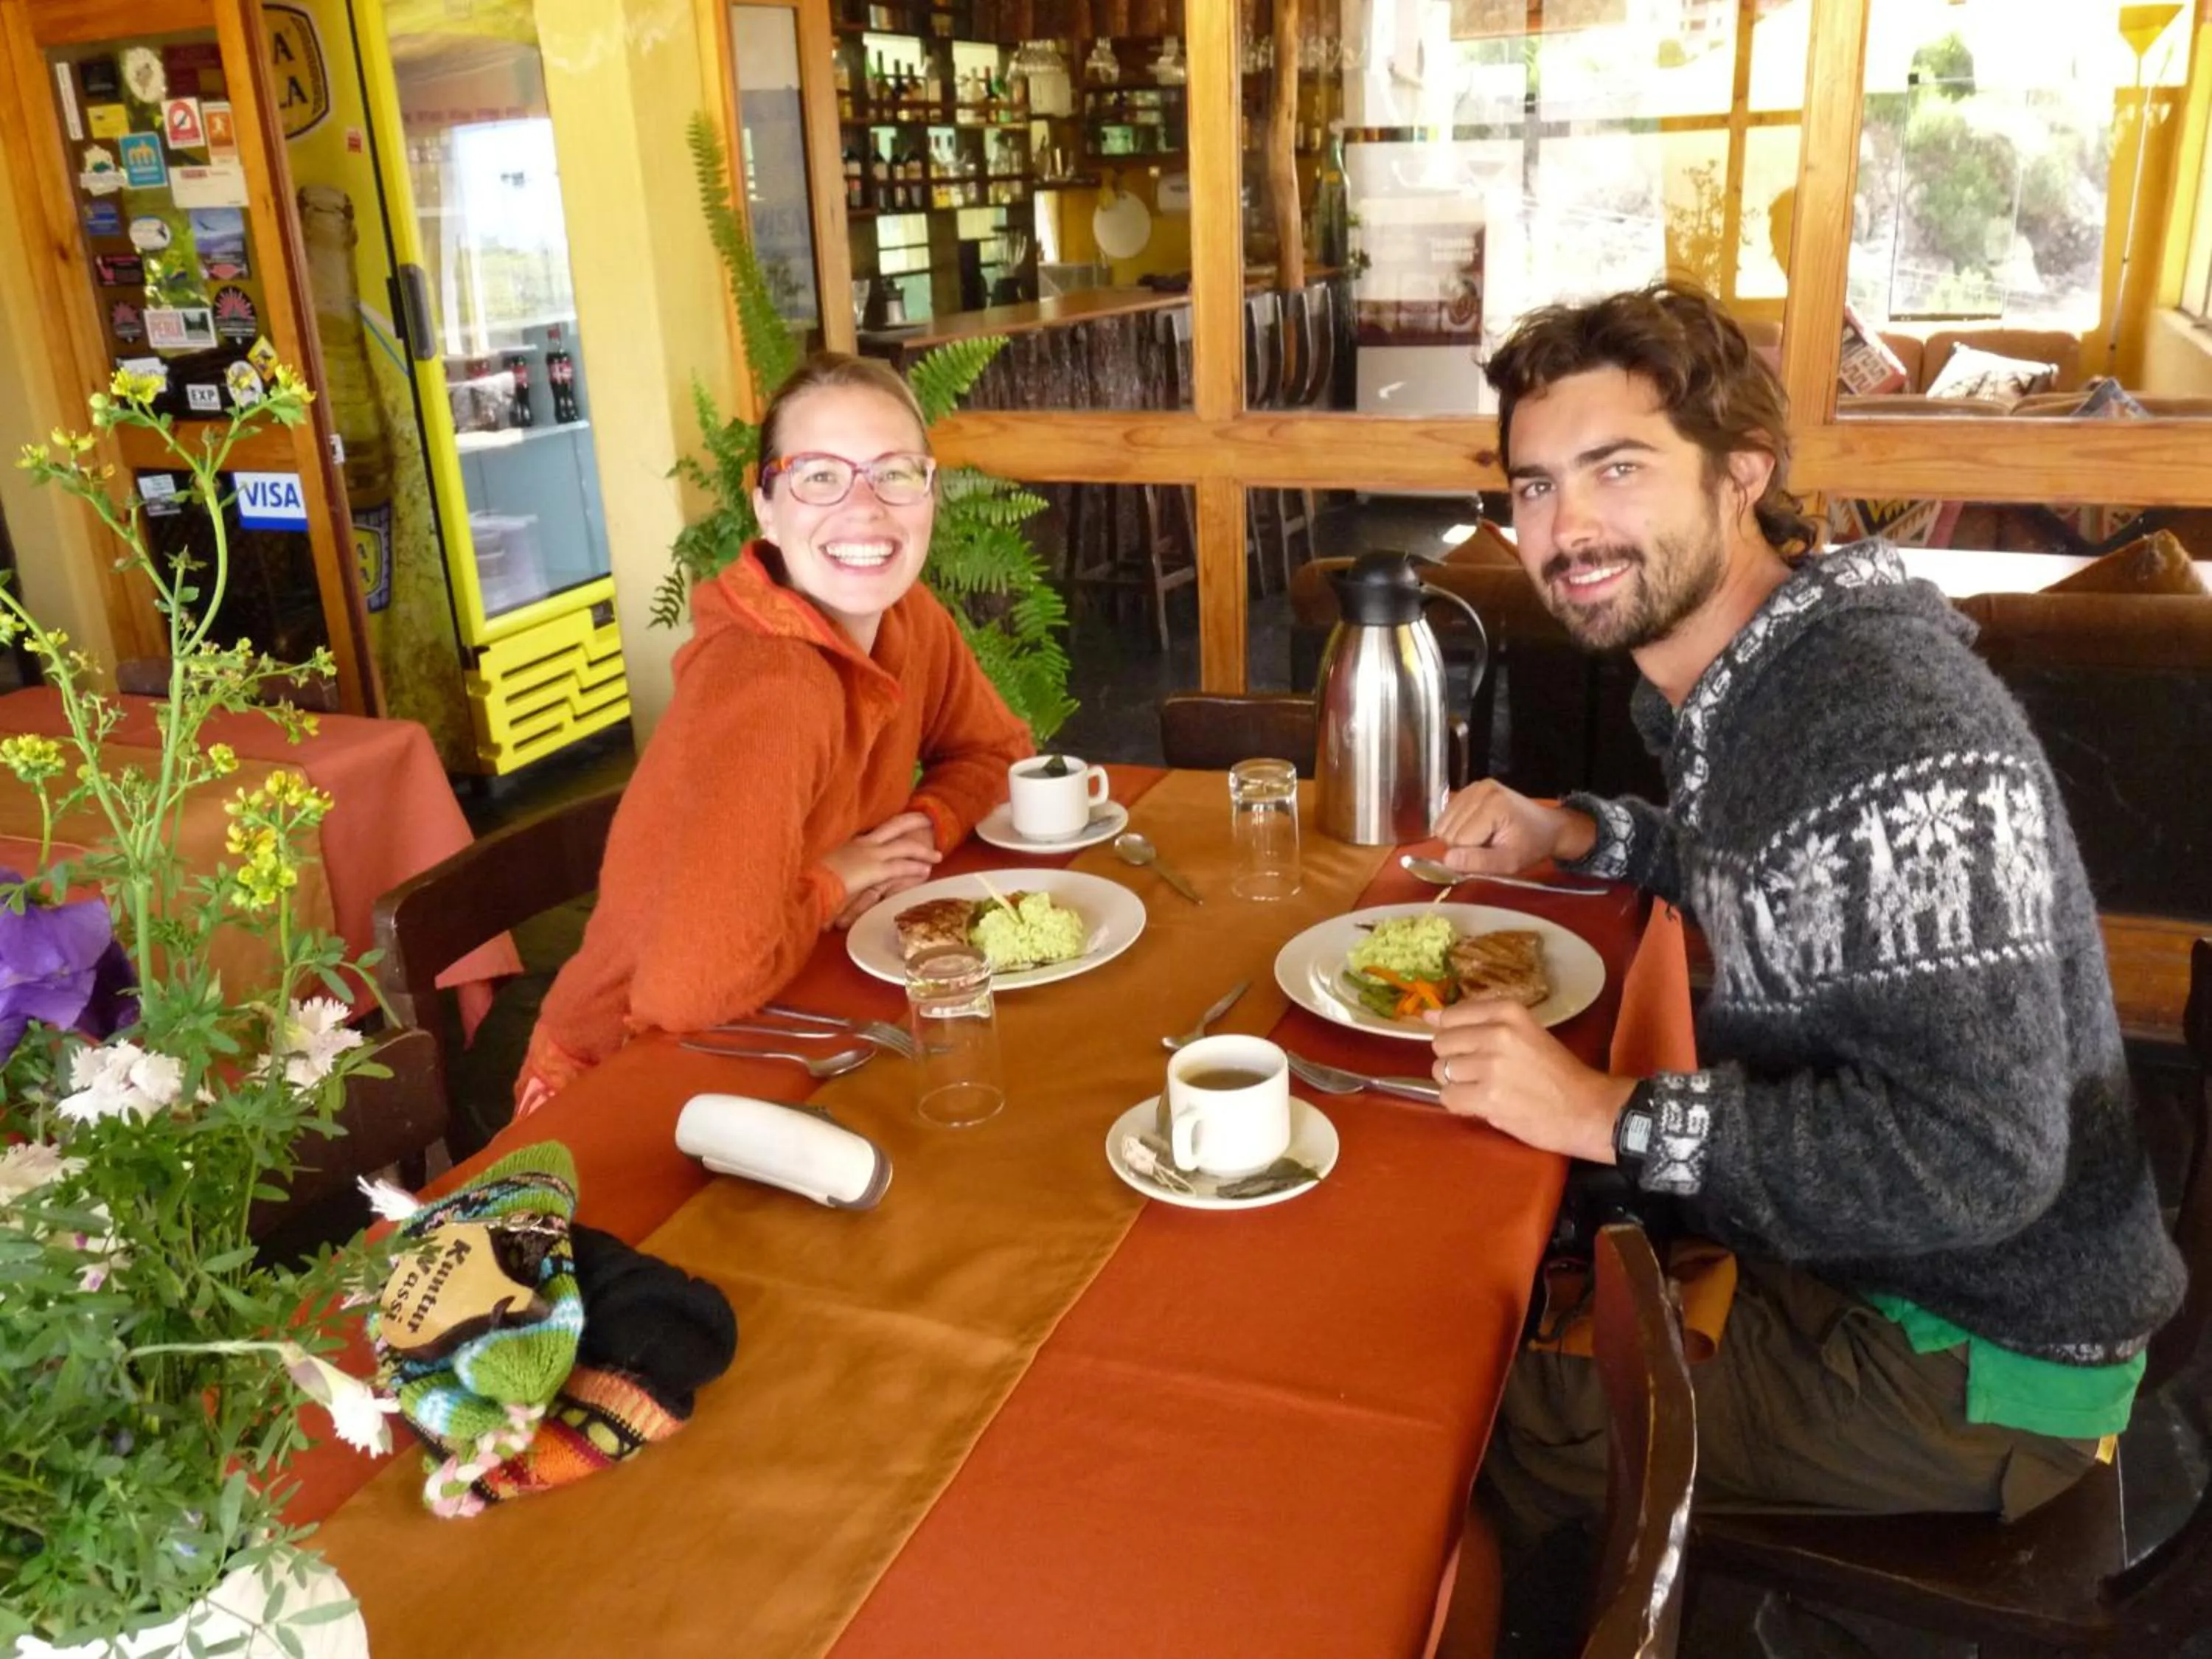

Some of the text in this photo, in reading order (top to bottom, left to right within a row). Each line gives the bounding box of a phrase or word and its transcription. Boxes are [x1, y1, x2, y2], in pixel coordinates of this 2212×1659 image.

[191, 389, 215, 402] EXP
[243, 481, 301, 508] VISA
[407, 1238, 472, 1333] Kuntur
